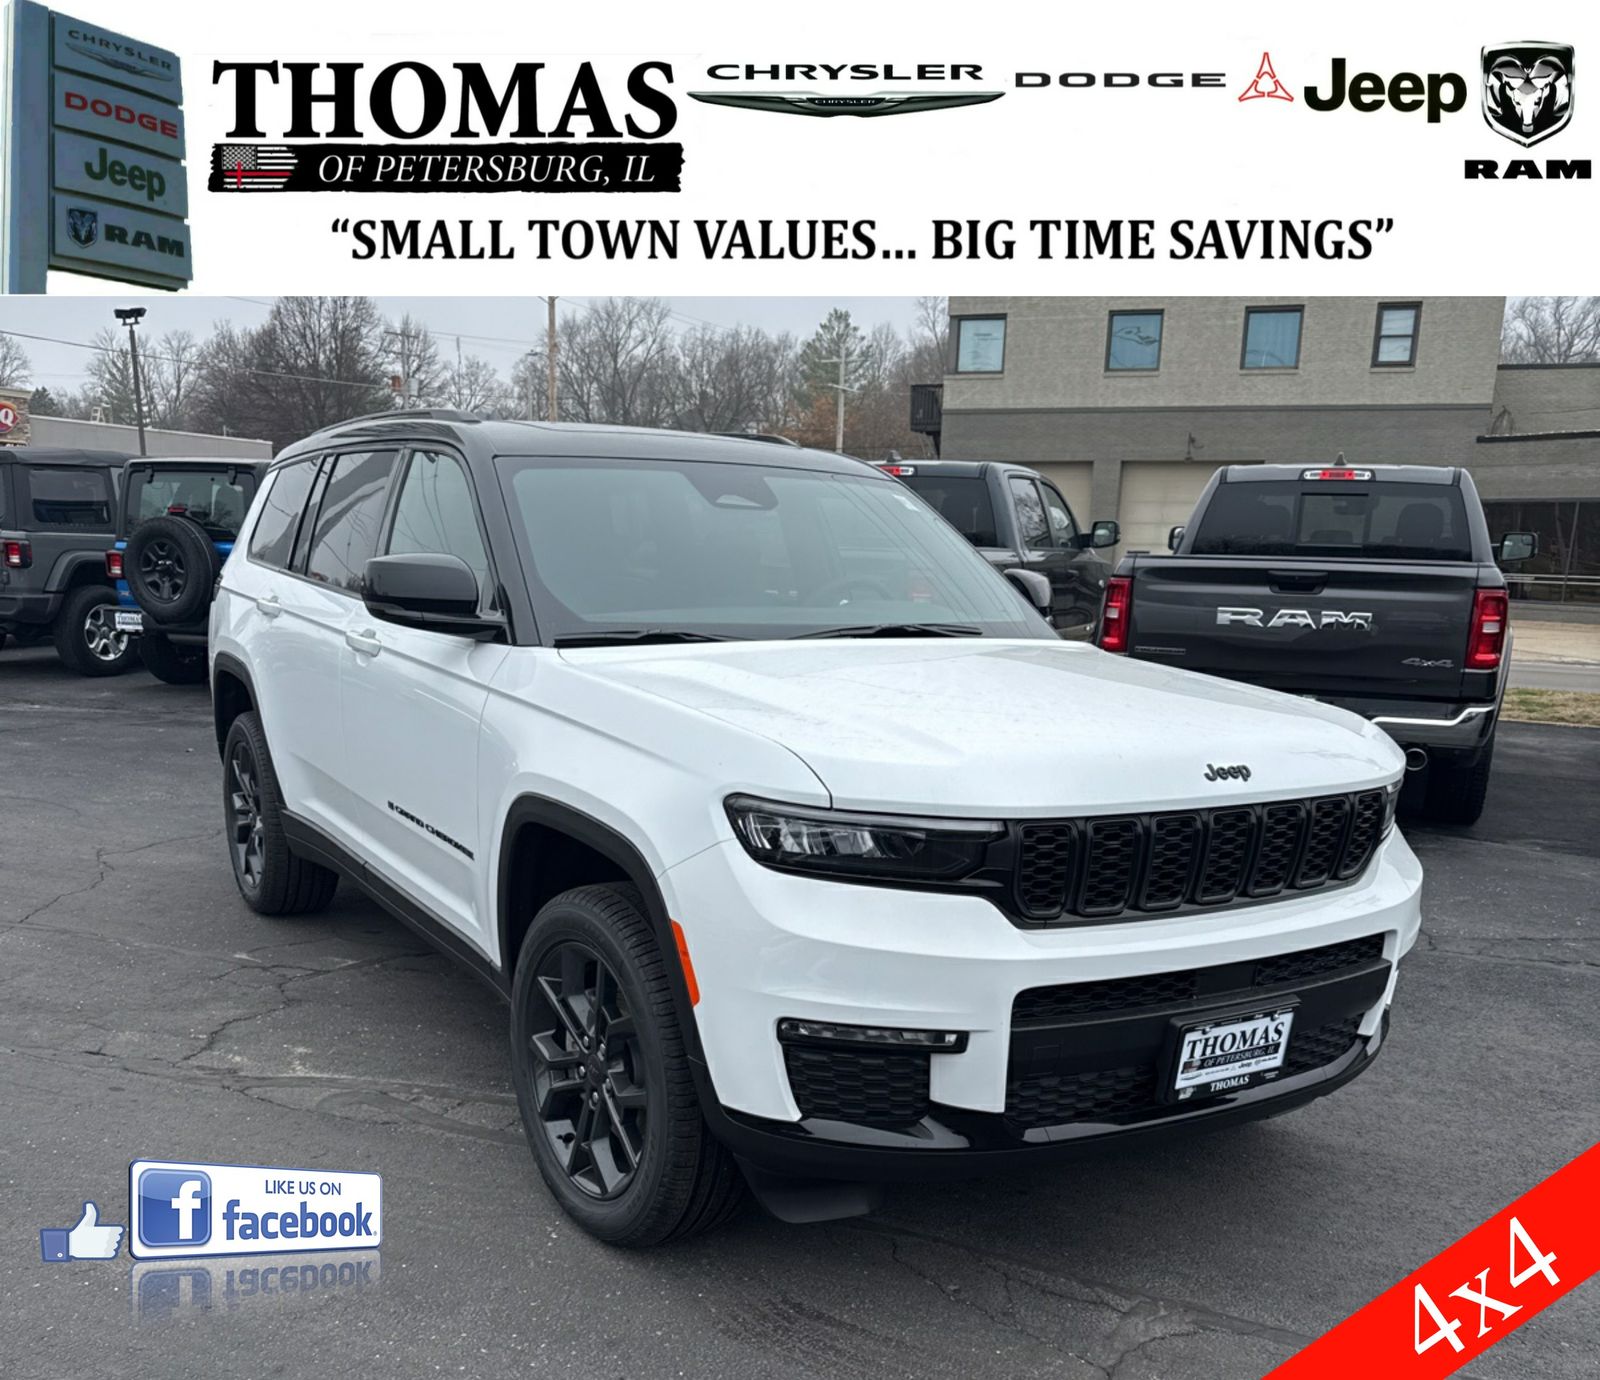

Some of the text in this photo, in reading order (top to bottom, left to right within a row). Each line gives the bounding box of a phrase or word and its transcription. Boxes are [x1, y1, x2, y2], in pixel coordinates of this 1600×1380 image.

[1216, 607, 1373, 631] RAM
[1204, 763, 1251, 782] Jeep
[1187, 1022, 1284, 1060] THOMAS
[1210, 1075, 1250, 1092] THOMAS
